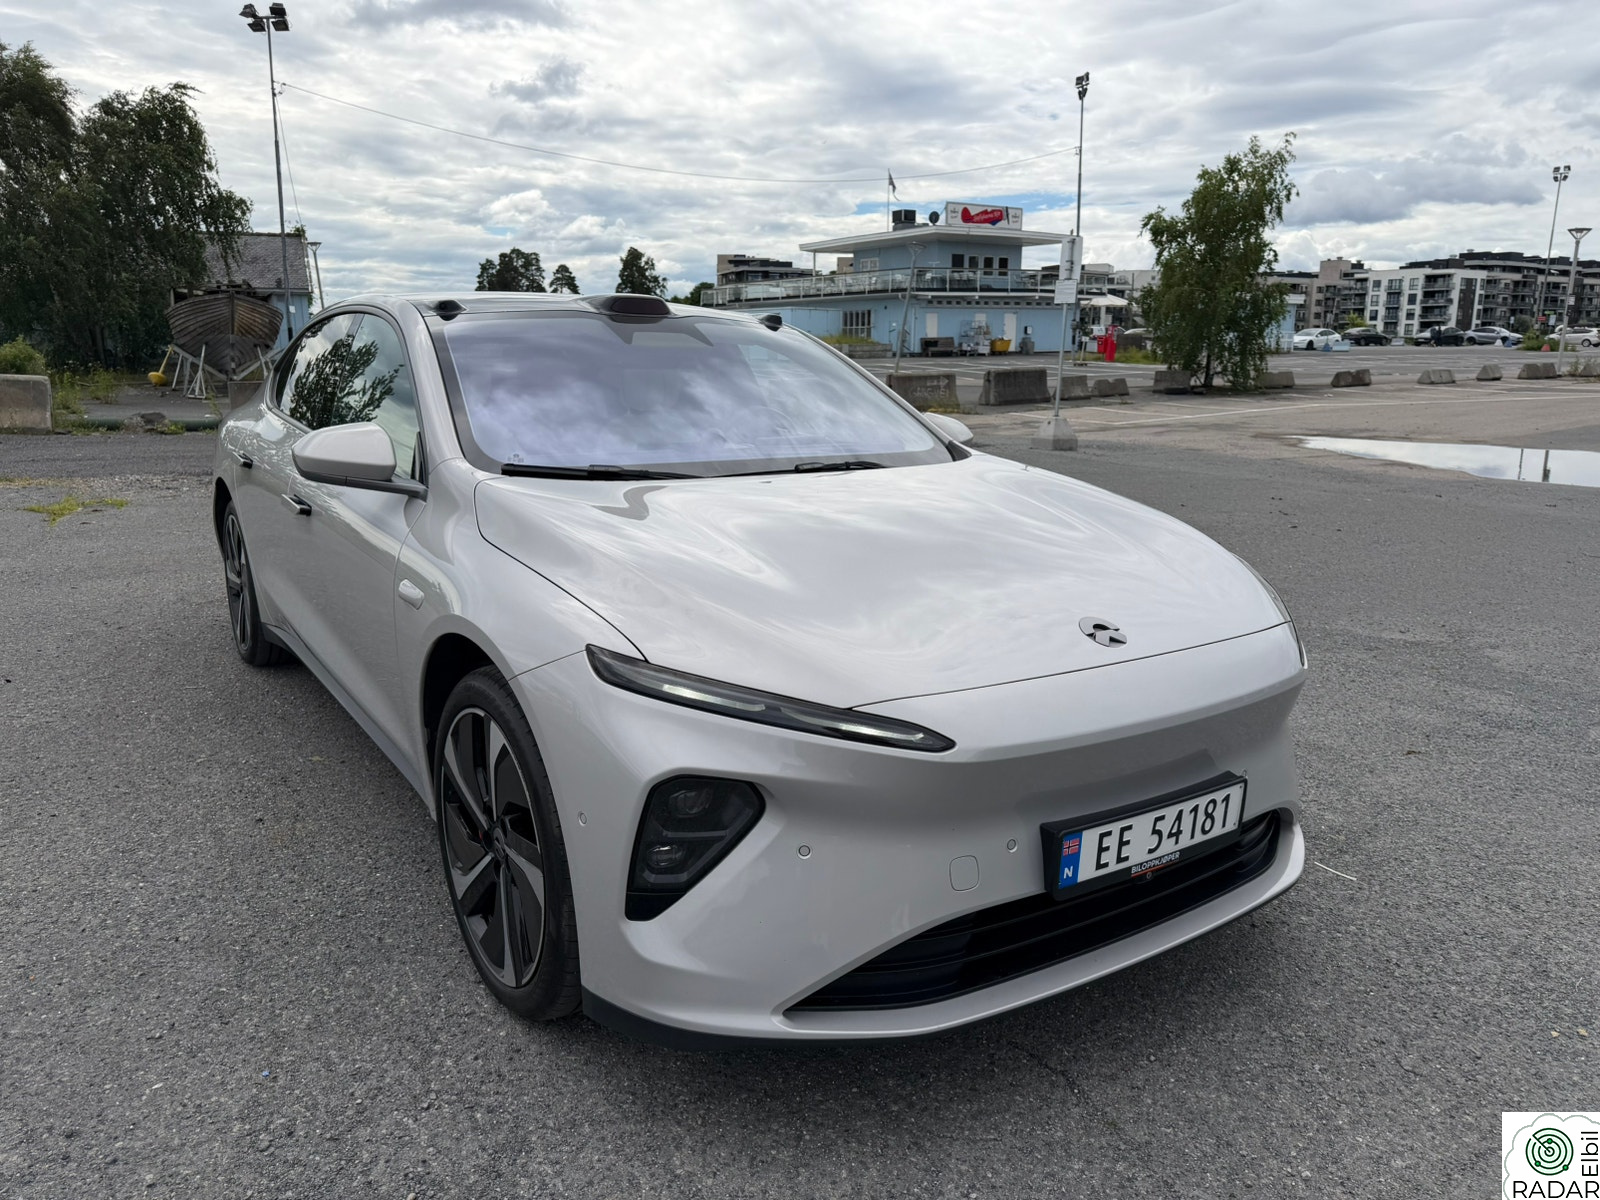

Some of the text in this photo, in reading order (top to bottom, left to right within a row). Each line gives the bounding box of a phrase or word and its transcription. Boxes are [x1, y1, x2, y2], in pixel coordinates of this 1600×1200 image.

[1095, 793, 1231, 871] EE 54181
[1063, 866, 1074, 879] N
[1131, 851, 1180, 873] BILOPPKJØPER
